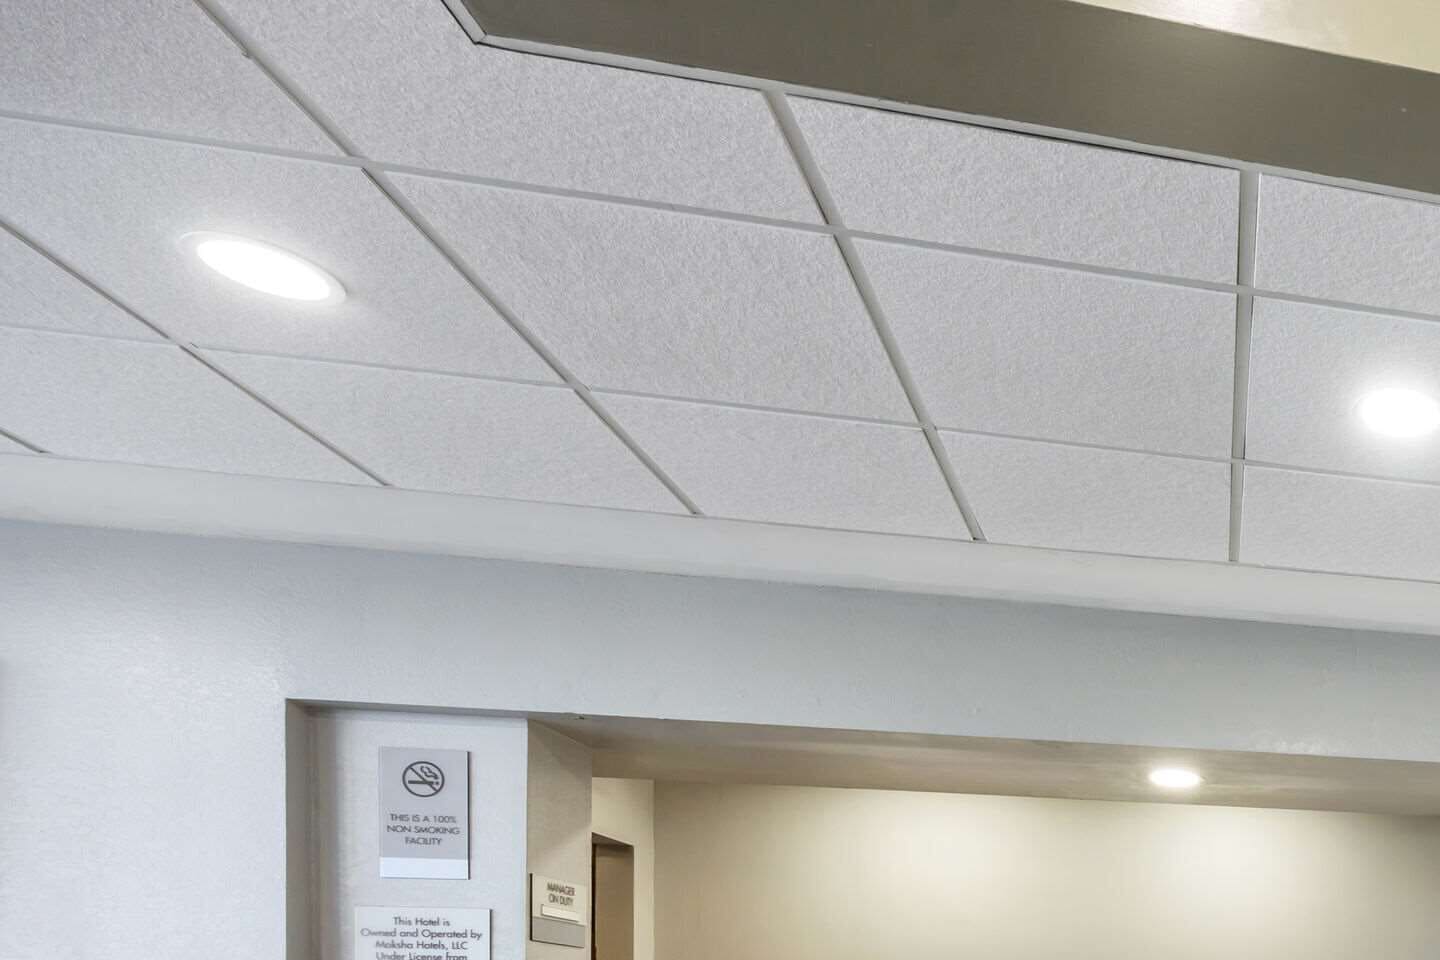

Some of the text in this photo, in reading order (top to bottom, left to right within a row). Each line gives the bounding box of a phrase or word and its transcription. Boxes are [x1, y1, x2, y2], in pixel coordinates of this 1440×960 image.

[390, 813, 409, 822] THIS
[412, 814, 420, 822] IS
[433, 815, 457, 823] 100%
[387, 825, 461, 835] NON SMOKING
[405, 836, 442, 845] FACILITY
[547, 882, 575, 896] MANAGER
[549, 893, 574, 906] ON DUTY
[392, 916, 451, 926] This Hotel is
[360, 928, 483, 940] Owned and Operated by
[416, 940, 449, 951] Hotels,
[452, 941, 469, 950] LLC
[376, 951, 468, 960] Under License from
